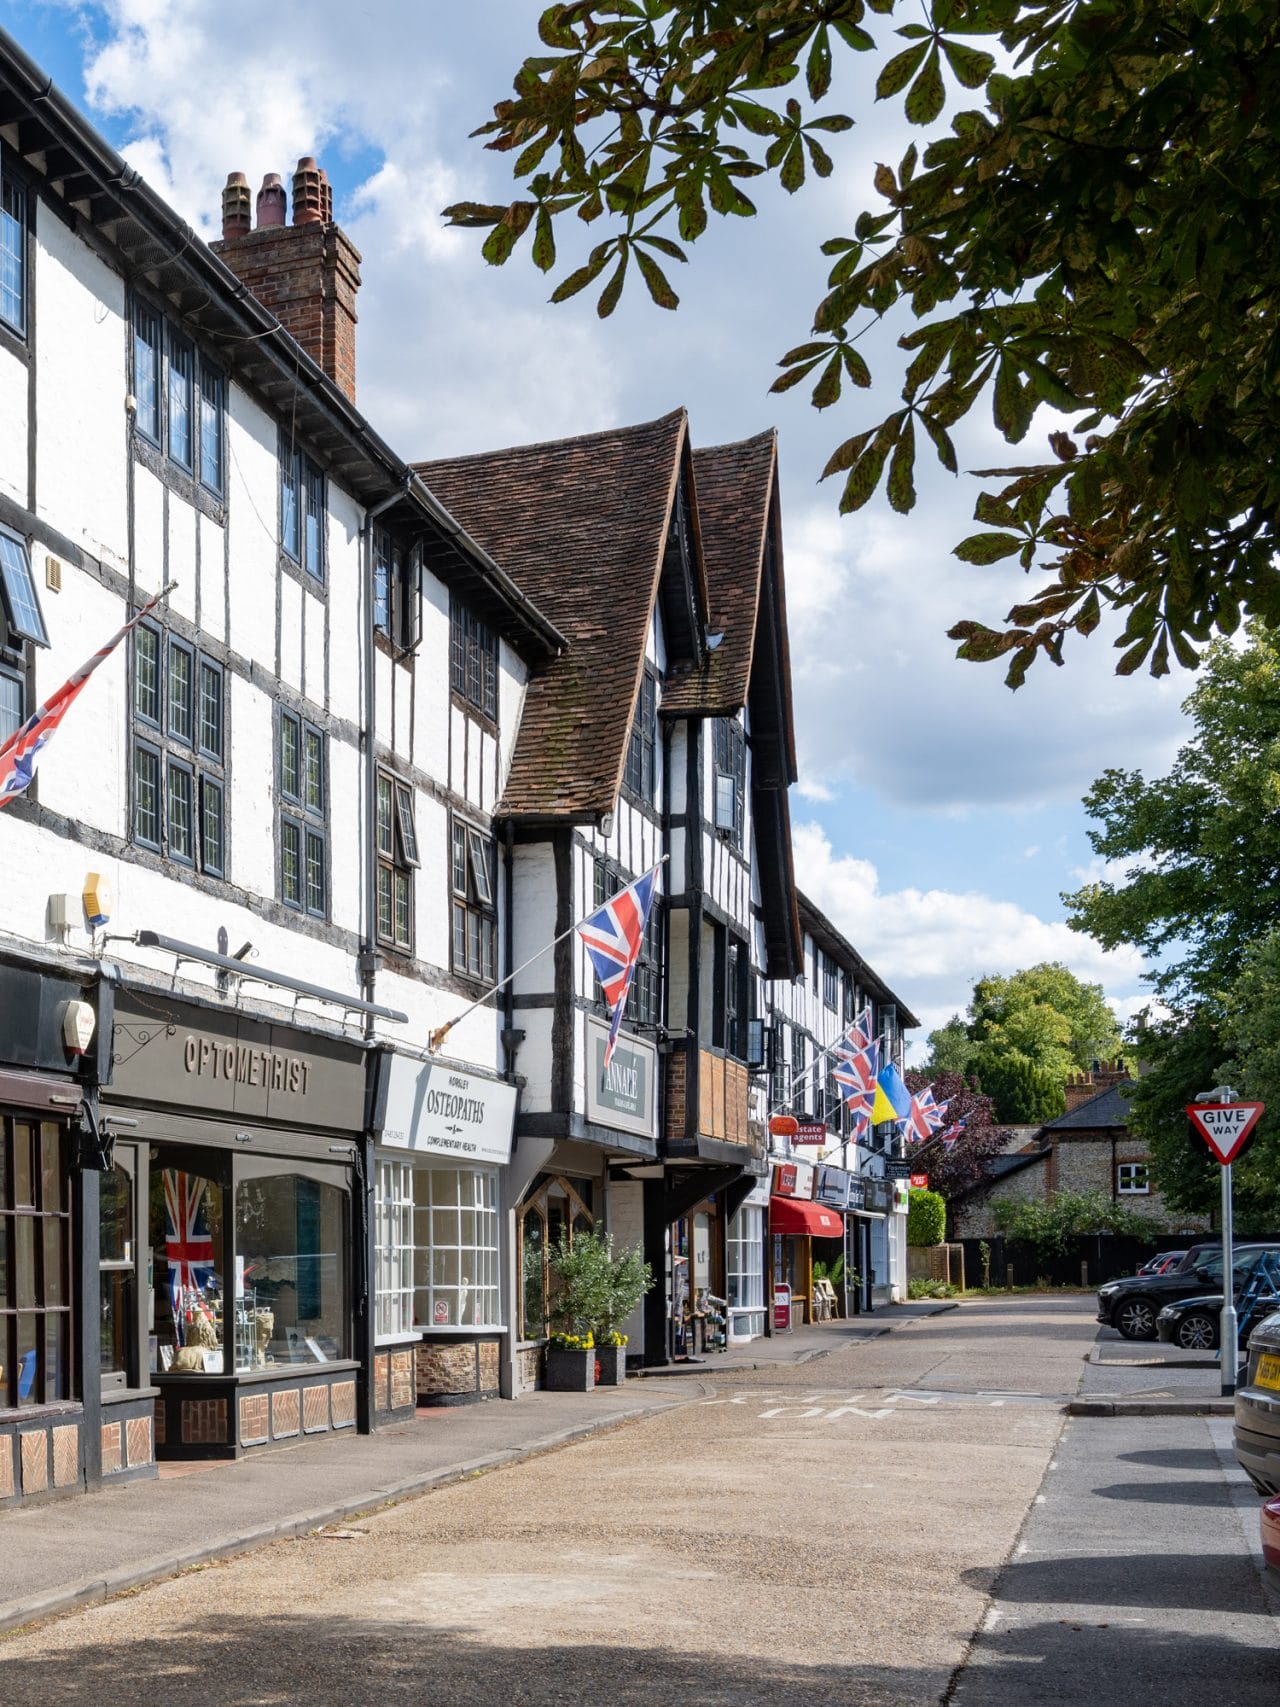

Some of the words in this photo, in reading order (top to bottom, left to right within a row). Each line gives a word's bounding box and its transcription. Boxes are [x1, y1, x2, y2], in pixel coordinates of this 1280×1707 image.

[184, 1034, 313, 1095] OPTOMETRIST
[448, 1076, 469, 1090] HORSLEY
[426, 1089, 485, 1125] OSTEOPATHS
[1203, 1110, 1246, 1123] GIVE
[1213, 1126, 1239, 1135] WAY
[793, 1134, 823, 1143] agents
[462, 1140, 477, 1153] HEALTH
